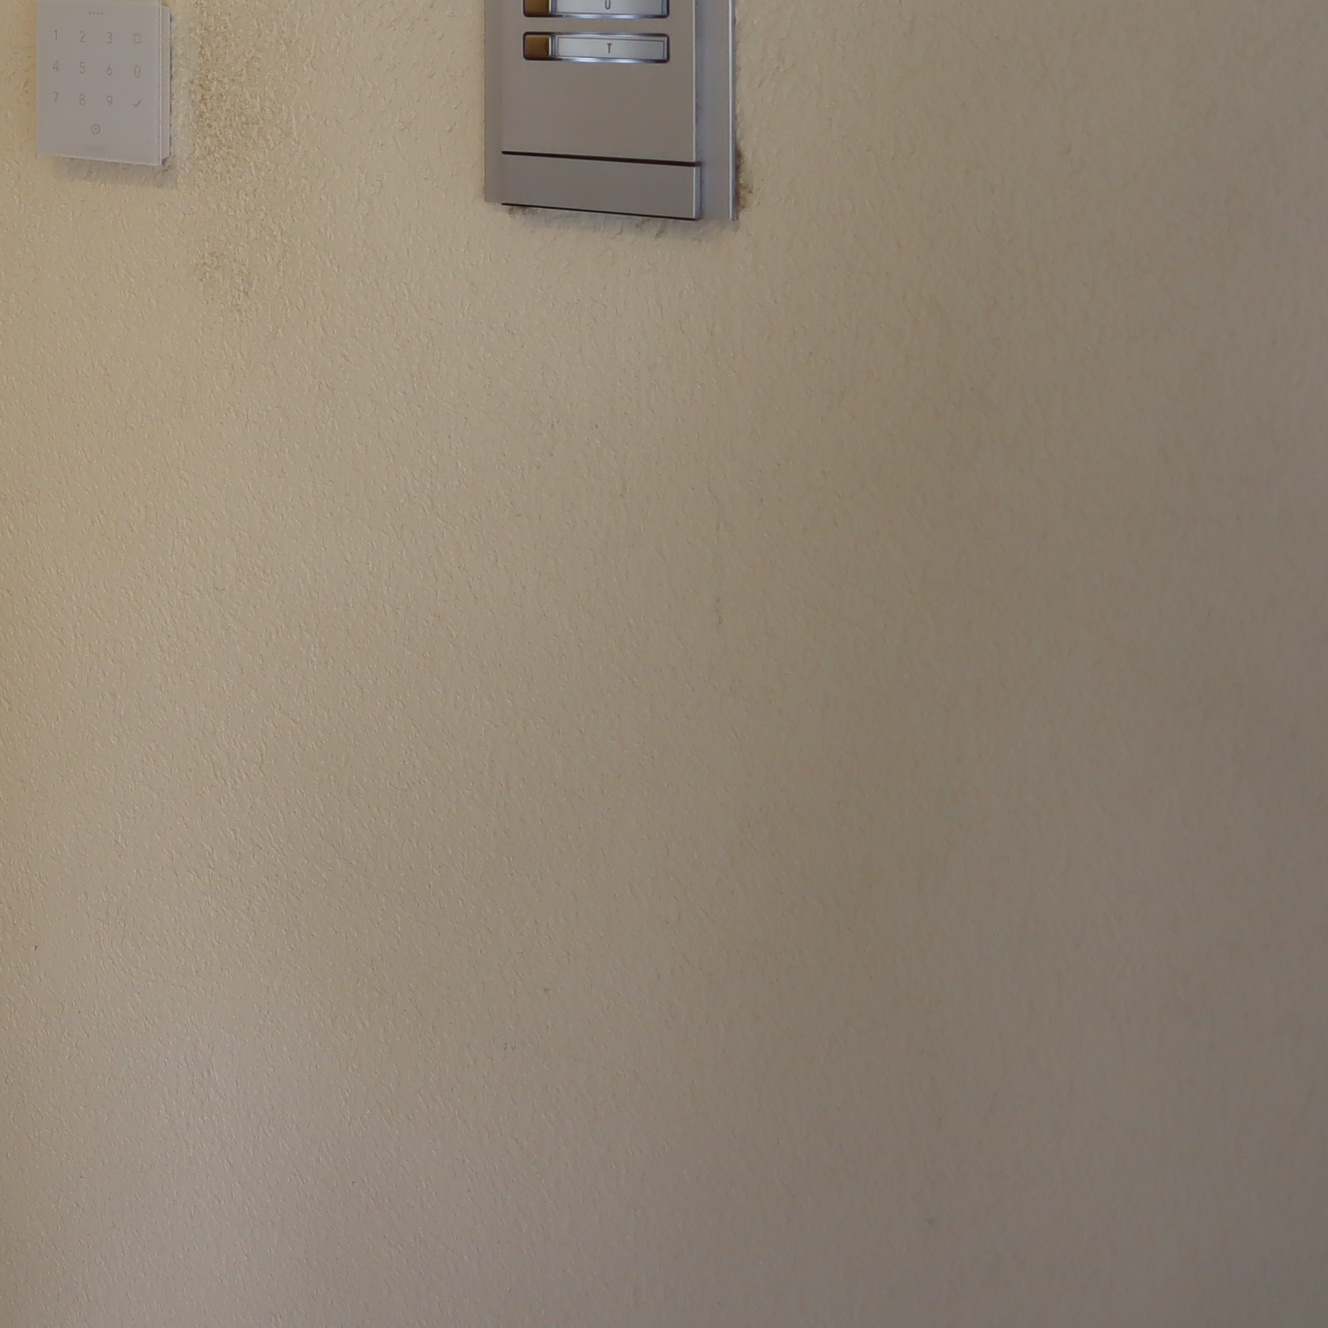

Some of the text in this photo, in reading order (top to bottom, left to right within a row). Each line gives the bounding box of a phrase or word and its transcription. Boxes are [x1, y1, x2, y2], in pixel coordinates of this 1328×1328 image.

[604, 0, 611, 10] U
[53, 29, 113, 44] 1 2 3
[607, 43, 612, 54] T
[52, 60, 59, 72] 4
[79, 62, 86, 74] 5
[106, 64, 113, 76] 6
[53, 92, 113, 106] 7 8 9
